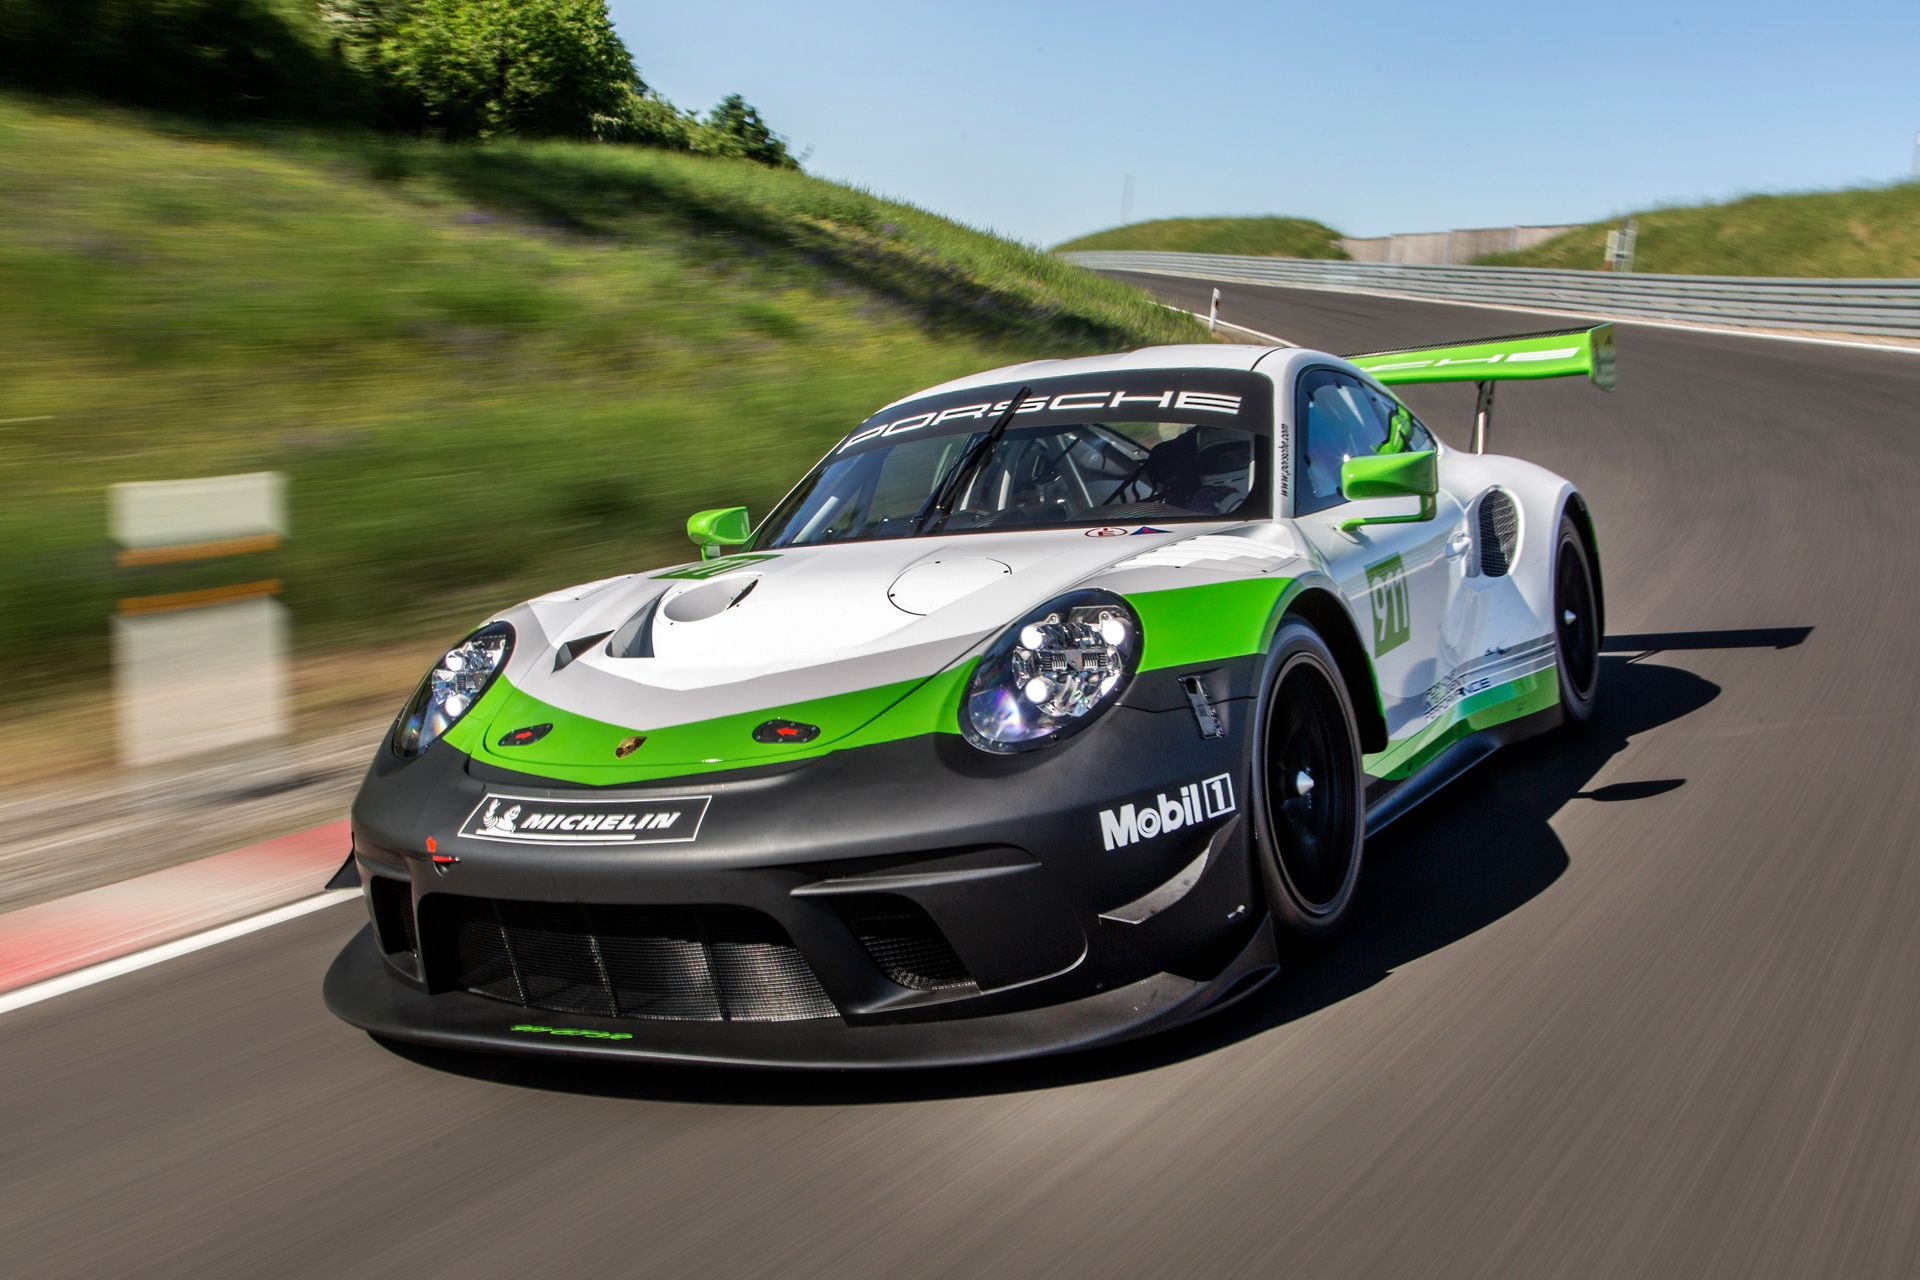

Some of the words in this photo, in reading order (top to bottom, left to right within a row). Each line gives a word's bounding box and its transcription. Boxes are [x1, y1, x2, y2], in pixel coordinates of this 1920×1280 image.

[1360, 347, 1581, 373] CHE
[836, 390, 1242, 455] PORSCHE
[1278, 423, 1291, 497] www.porsche.com
[1371, 567, 1408, 642] 911
[520, 811, 682, 831] MICHELIN
[1099, 783, 1204, 851] Mobil
